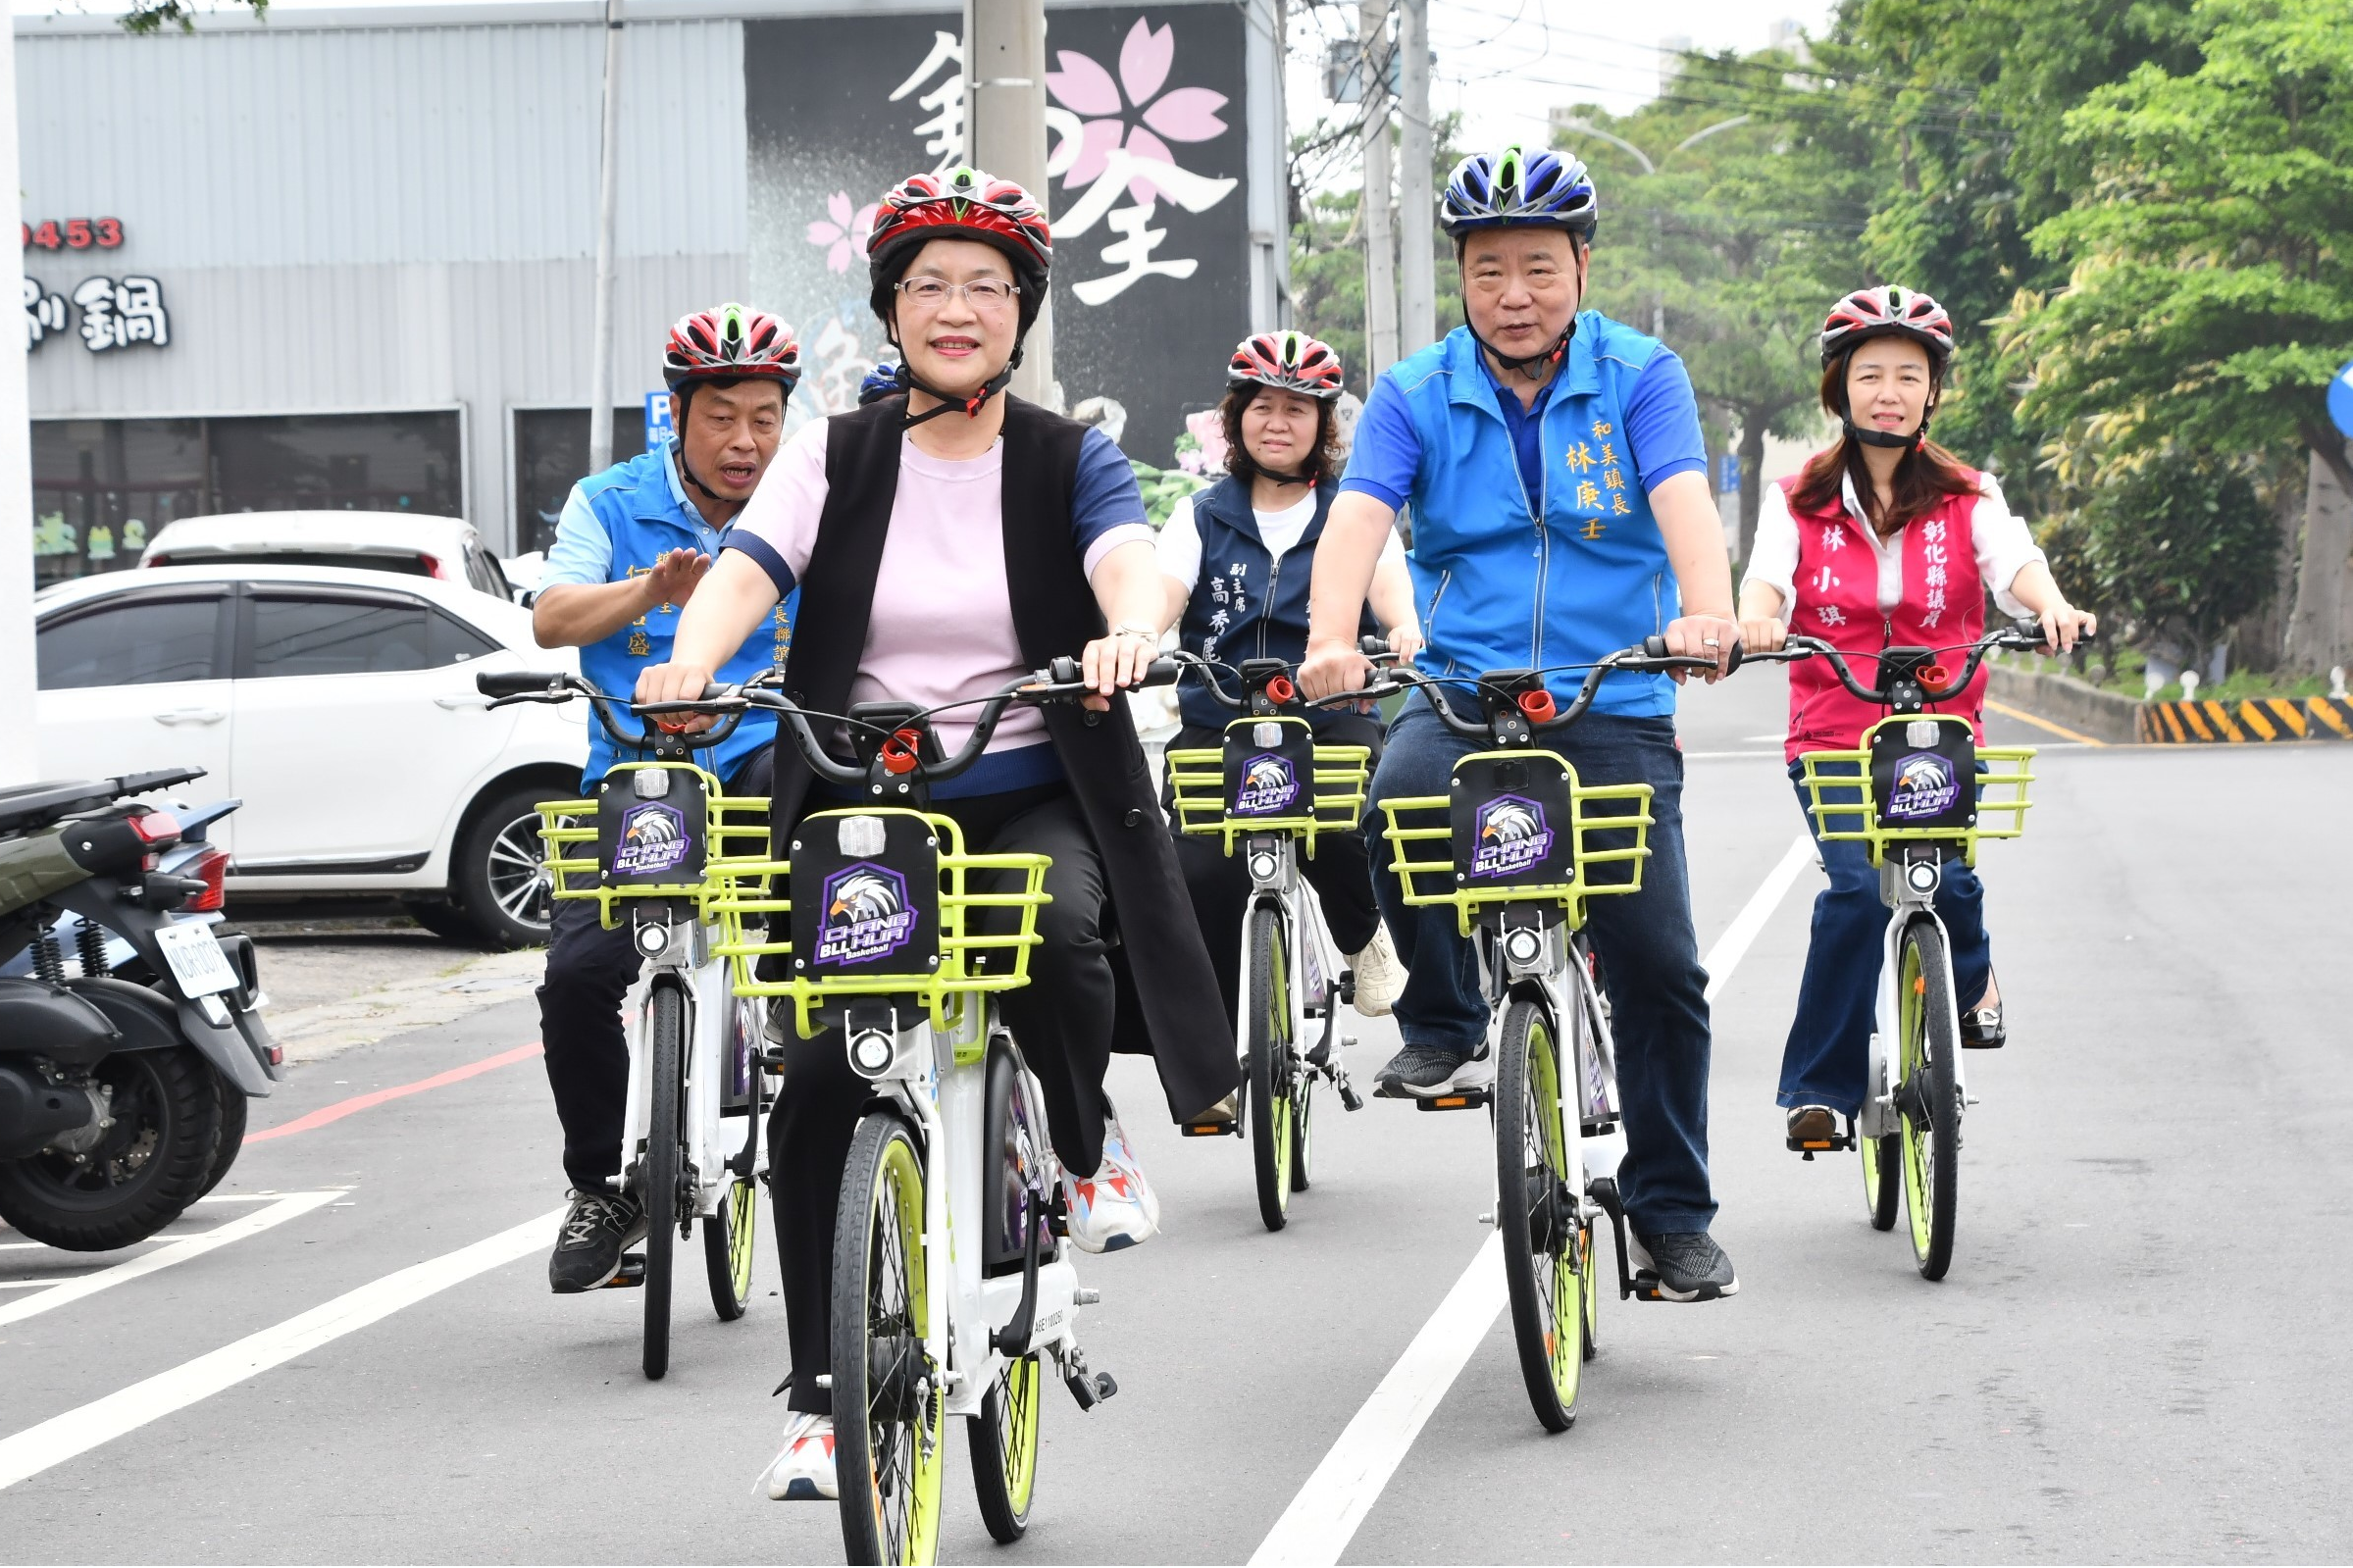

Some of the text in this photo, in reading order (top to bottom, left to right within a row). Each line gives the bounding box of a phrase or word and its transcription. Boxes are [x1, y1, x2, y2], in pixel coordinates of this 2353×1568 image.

[651, 395, 670, 425] P
[1565, 441, 1607, 540] 林庚壬
[1591, 420, 1632, 516] 和美鎮長
[1229, 563, 1248, 614] 副主席
[1813, 524, 1847, 628] 林小琪
[1918, 520, 1948, 629] 彰化縣議員
[1202, 576, 1231, 663] 高秀麗
[1497, 859, 1531, 874] Basketball
[845, 943, 889, 959] Basketball
